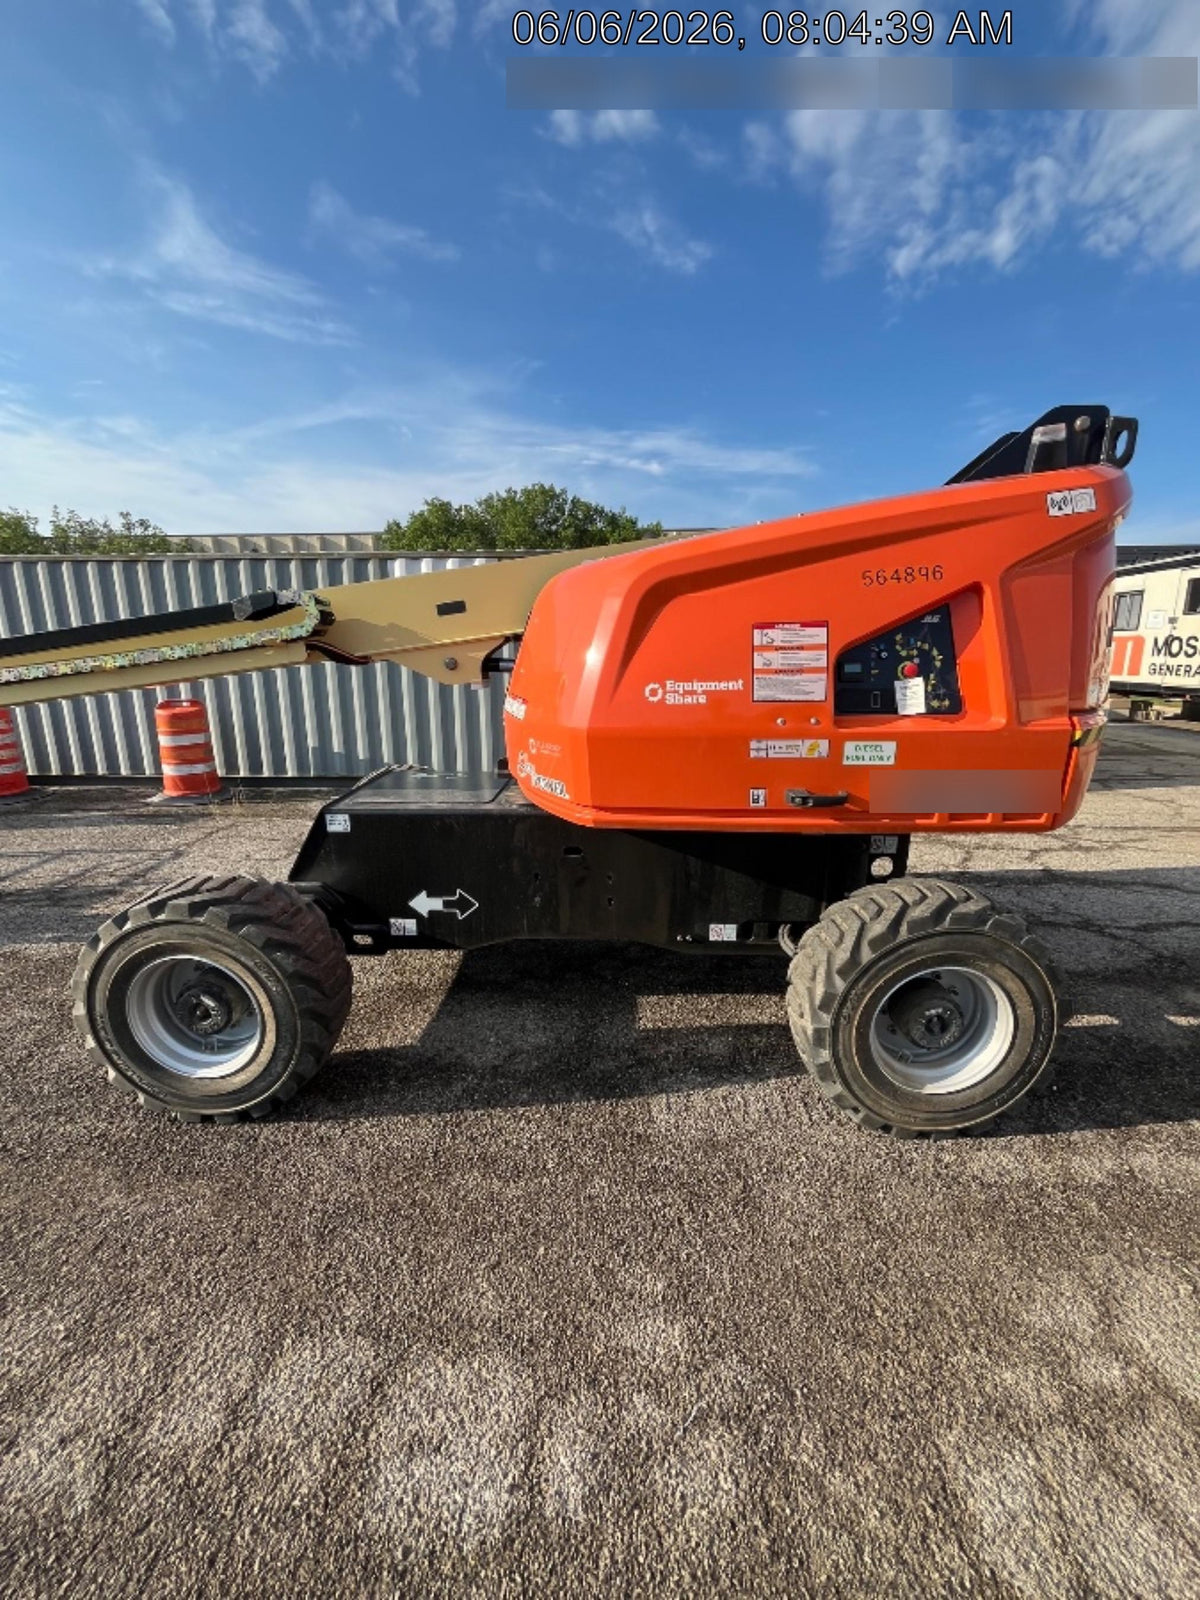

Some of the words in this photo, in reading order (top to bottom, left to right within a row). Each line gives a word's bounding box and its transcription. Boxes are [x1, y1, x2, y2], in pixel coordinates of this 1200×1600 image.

[862, 564, 945, 587] 564896
[1151, 635, 1200, 658] MOS
[665, 679, 744, 694] Equipment
[665, 693, 707, 704] Share
